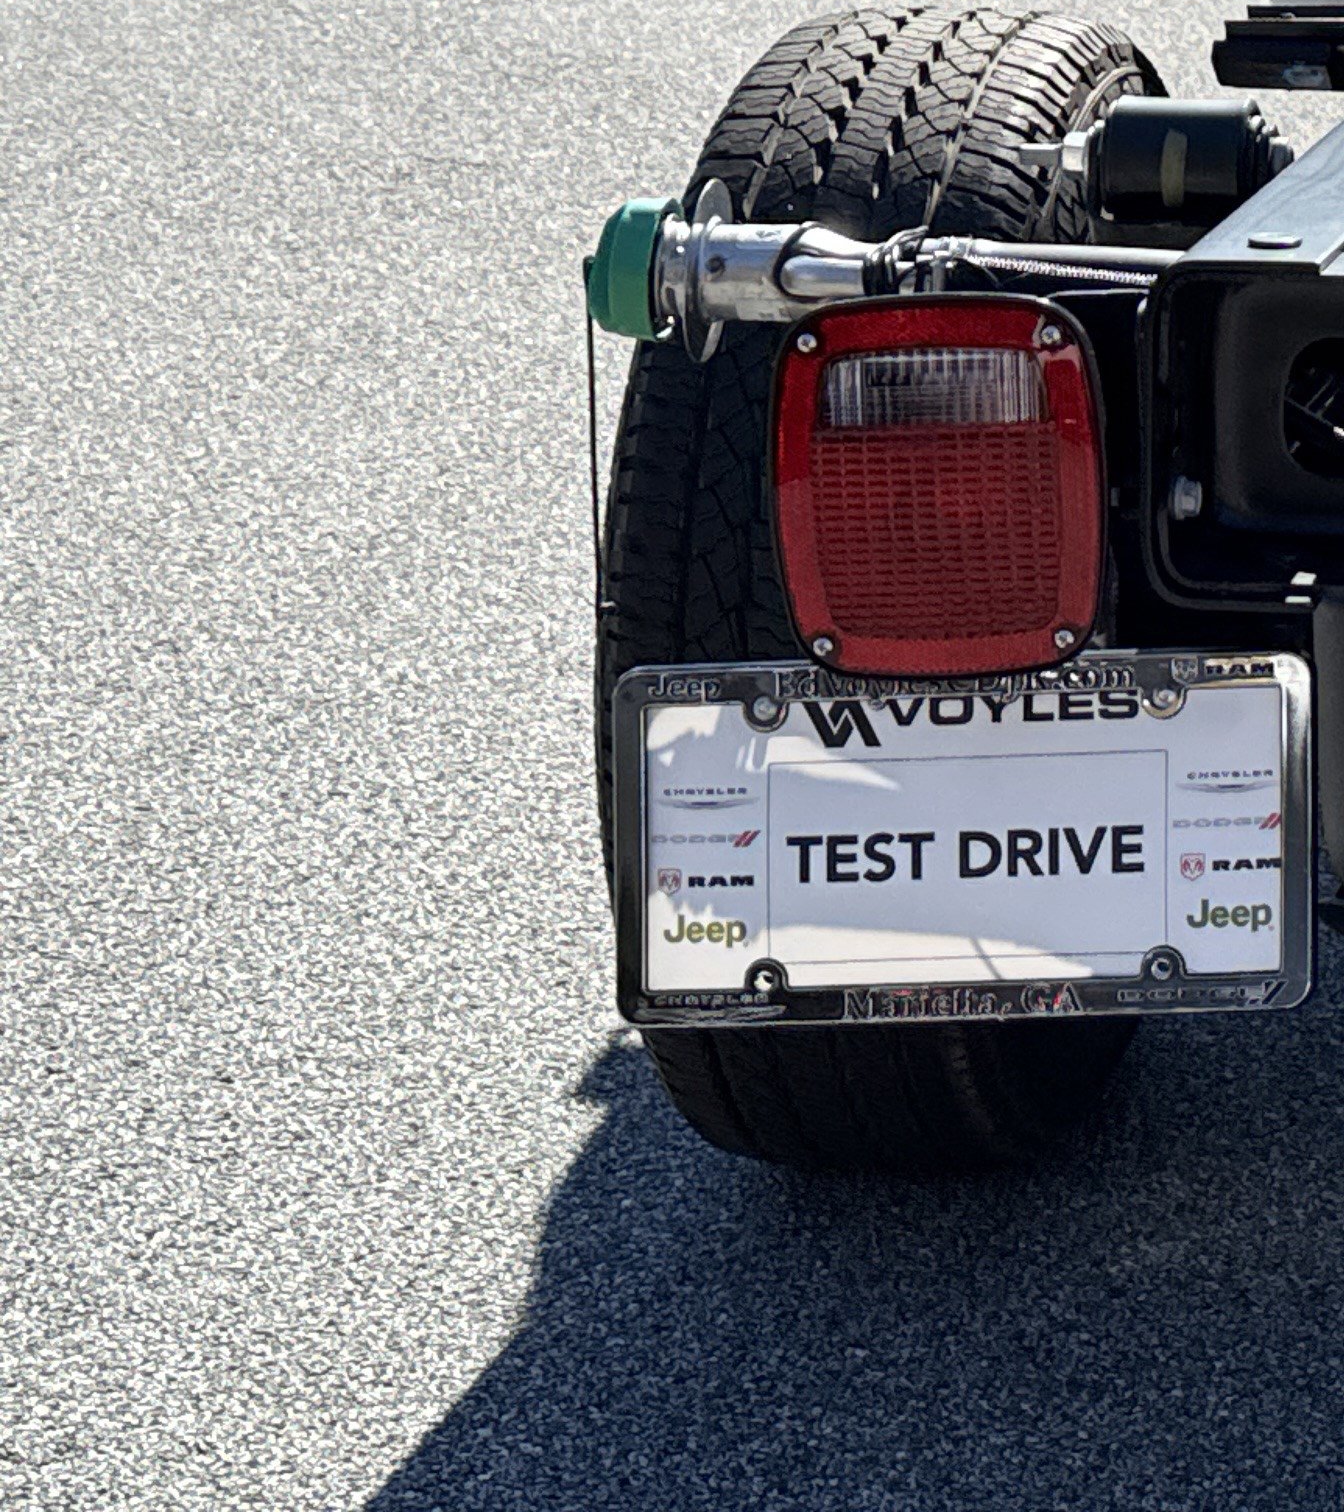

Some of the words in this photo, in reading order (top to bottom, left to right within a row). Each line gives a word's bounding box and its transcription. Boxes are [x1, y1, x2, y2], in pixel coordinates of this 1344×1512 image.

[1206, 662, 1275, 676] RAM
[650, 674, 721, 702] Jeep
[886, 689, 1139, 726] VOYLES
[1187, 769, 1274, 780] CHRYSLER
[663, 787, 747, 796] CHRYSLER
[786, 831, 935, 884] TEST
[959, 824, 1144, 878] DRIVE
[1212, 858, 1282, 871] RAM
[688, 875, 755, 888] RAM
[1186, 898, 1272, 933] Jeep
[663, 913, 747, 949] Jeep
[1020, 981, 1083, 1014] GA
